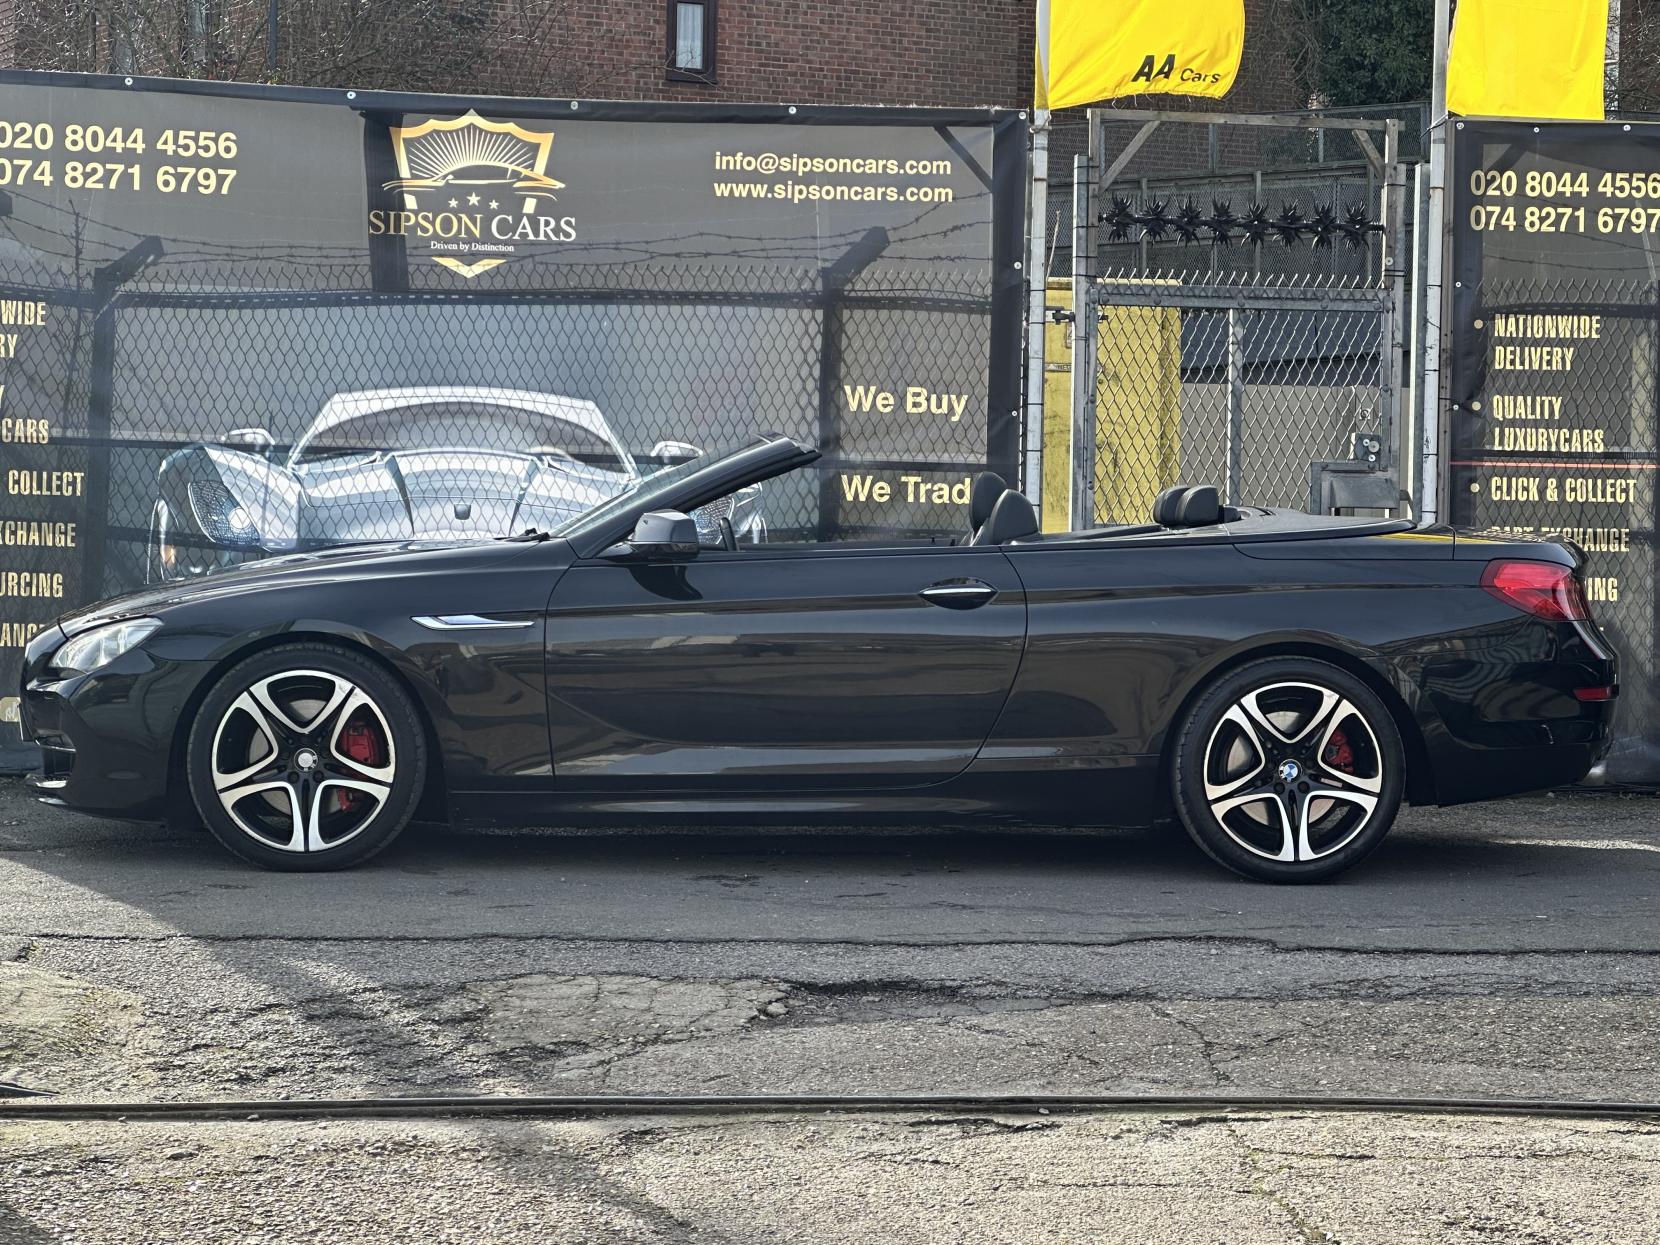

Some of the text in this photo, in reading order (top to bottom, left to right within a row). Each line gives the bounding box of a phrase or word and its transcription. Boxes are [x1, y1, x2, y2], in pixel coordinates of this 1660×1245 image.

[1131, 54, 1221, 83] AA Cars
[0, 121, 238, 159] 020 8044 4556
[0, 158, 237, 195] 074 8271 6797
[715, 152, 952, 176] info@sipsoncars.com
[714, 181, 953, 203] www.sipsoncars.com
[1470, 170, 1660, 199] 020 8044 4556
[369, 210, 577, 242] SIPSON CARS
[1470, 205, 1660, 233] 074 8271 6797
[430, 241, 515, 252] Driven by Distinction
[0, 300, 46, 326] WIDE
[1494, 314, 1600, 339] NATIONWIDE
[1494, 346, 1574, 371] DELIVERY
[844, 385, 969, 422] We Buy
[1493, 395, 1563, 421] QUALITY
[1, 418, 49, 444] CARS
[1494, 427, 1604, 453] LUXURYCARS
[8, 470, 84, 496] COLLECT
[841, 474, 971, 505] We Trad
[1491, 476, 1637, 503] CLICK & COLLECT
[1584, 577, 1618, 601] ING
